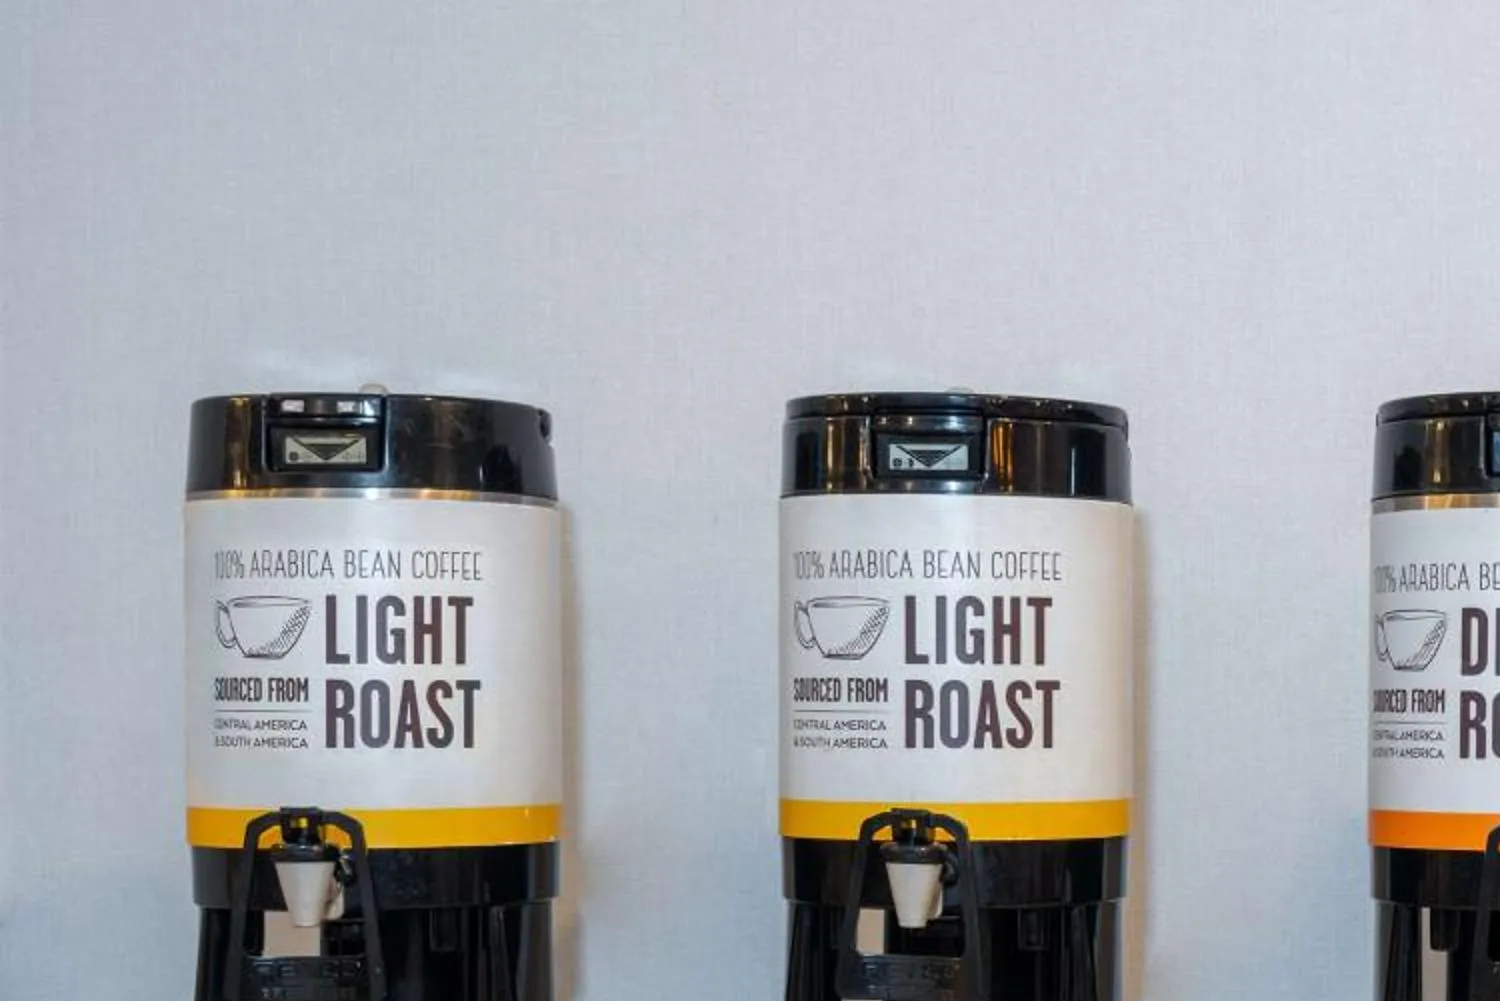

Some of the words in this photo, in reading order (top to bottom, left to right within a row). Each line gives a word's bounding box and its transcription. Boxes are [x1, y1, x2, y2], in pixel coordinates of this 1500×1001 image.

[250, 549, 335, 579] ARABICA
[343, 549, 401, 579] BEAN
[411, 551, 482, 581] COFFEE
[830, 549, 913, 579] ARABICA
[923, 549, 981, 579] BEAN
[991, 551, 1062, 581] COFFEE
[1399, 563, 1470, 591] ARABICA
[325, 594, 474, 664] LIGHT
[904, 595, 1053, 665] LIGHT
[214, 677, 262, 702] SOURCED
[267, 677, 309, 703] FROM
[793, 677, 841, 702] SOURCED
[847, 677, 888, 703] FROM
[1373, 688, 1406, 713] RCED
[1411, 688, 1445, 713] FROM
[253, 719, 308, 731] AMERICA
[325, 679, 481, 749] ROAST
[833, 719, 887, 731] AMERICA
[904, 679, 1060, 749] ROAST
[253, 737, 309, 749] AMERICA
[832, 737, 888, 749] AMERICA
